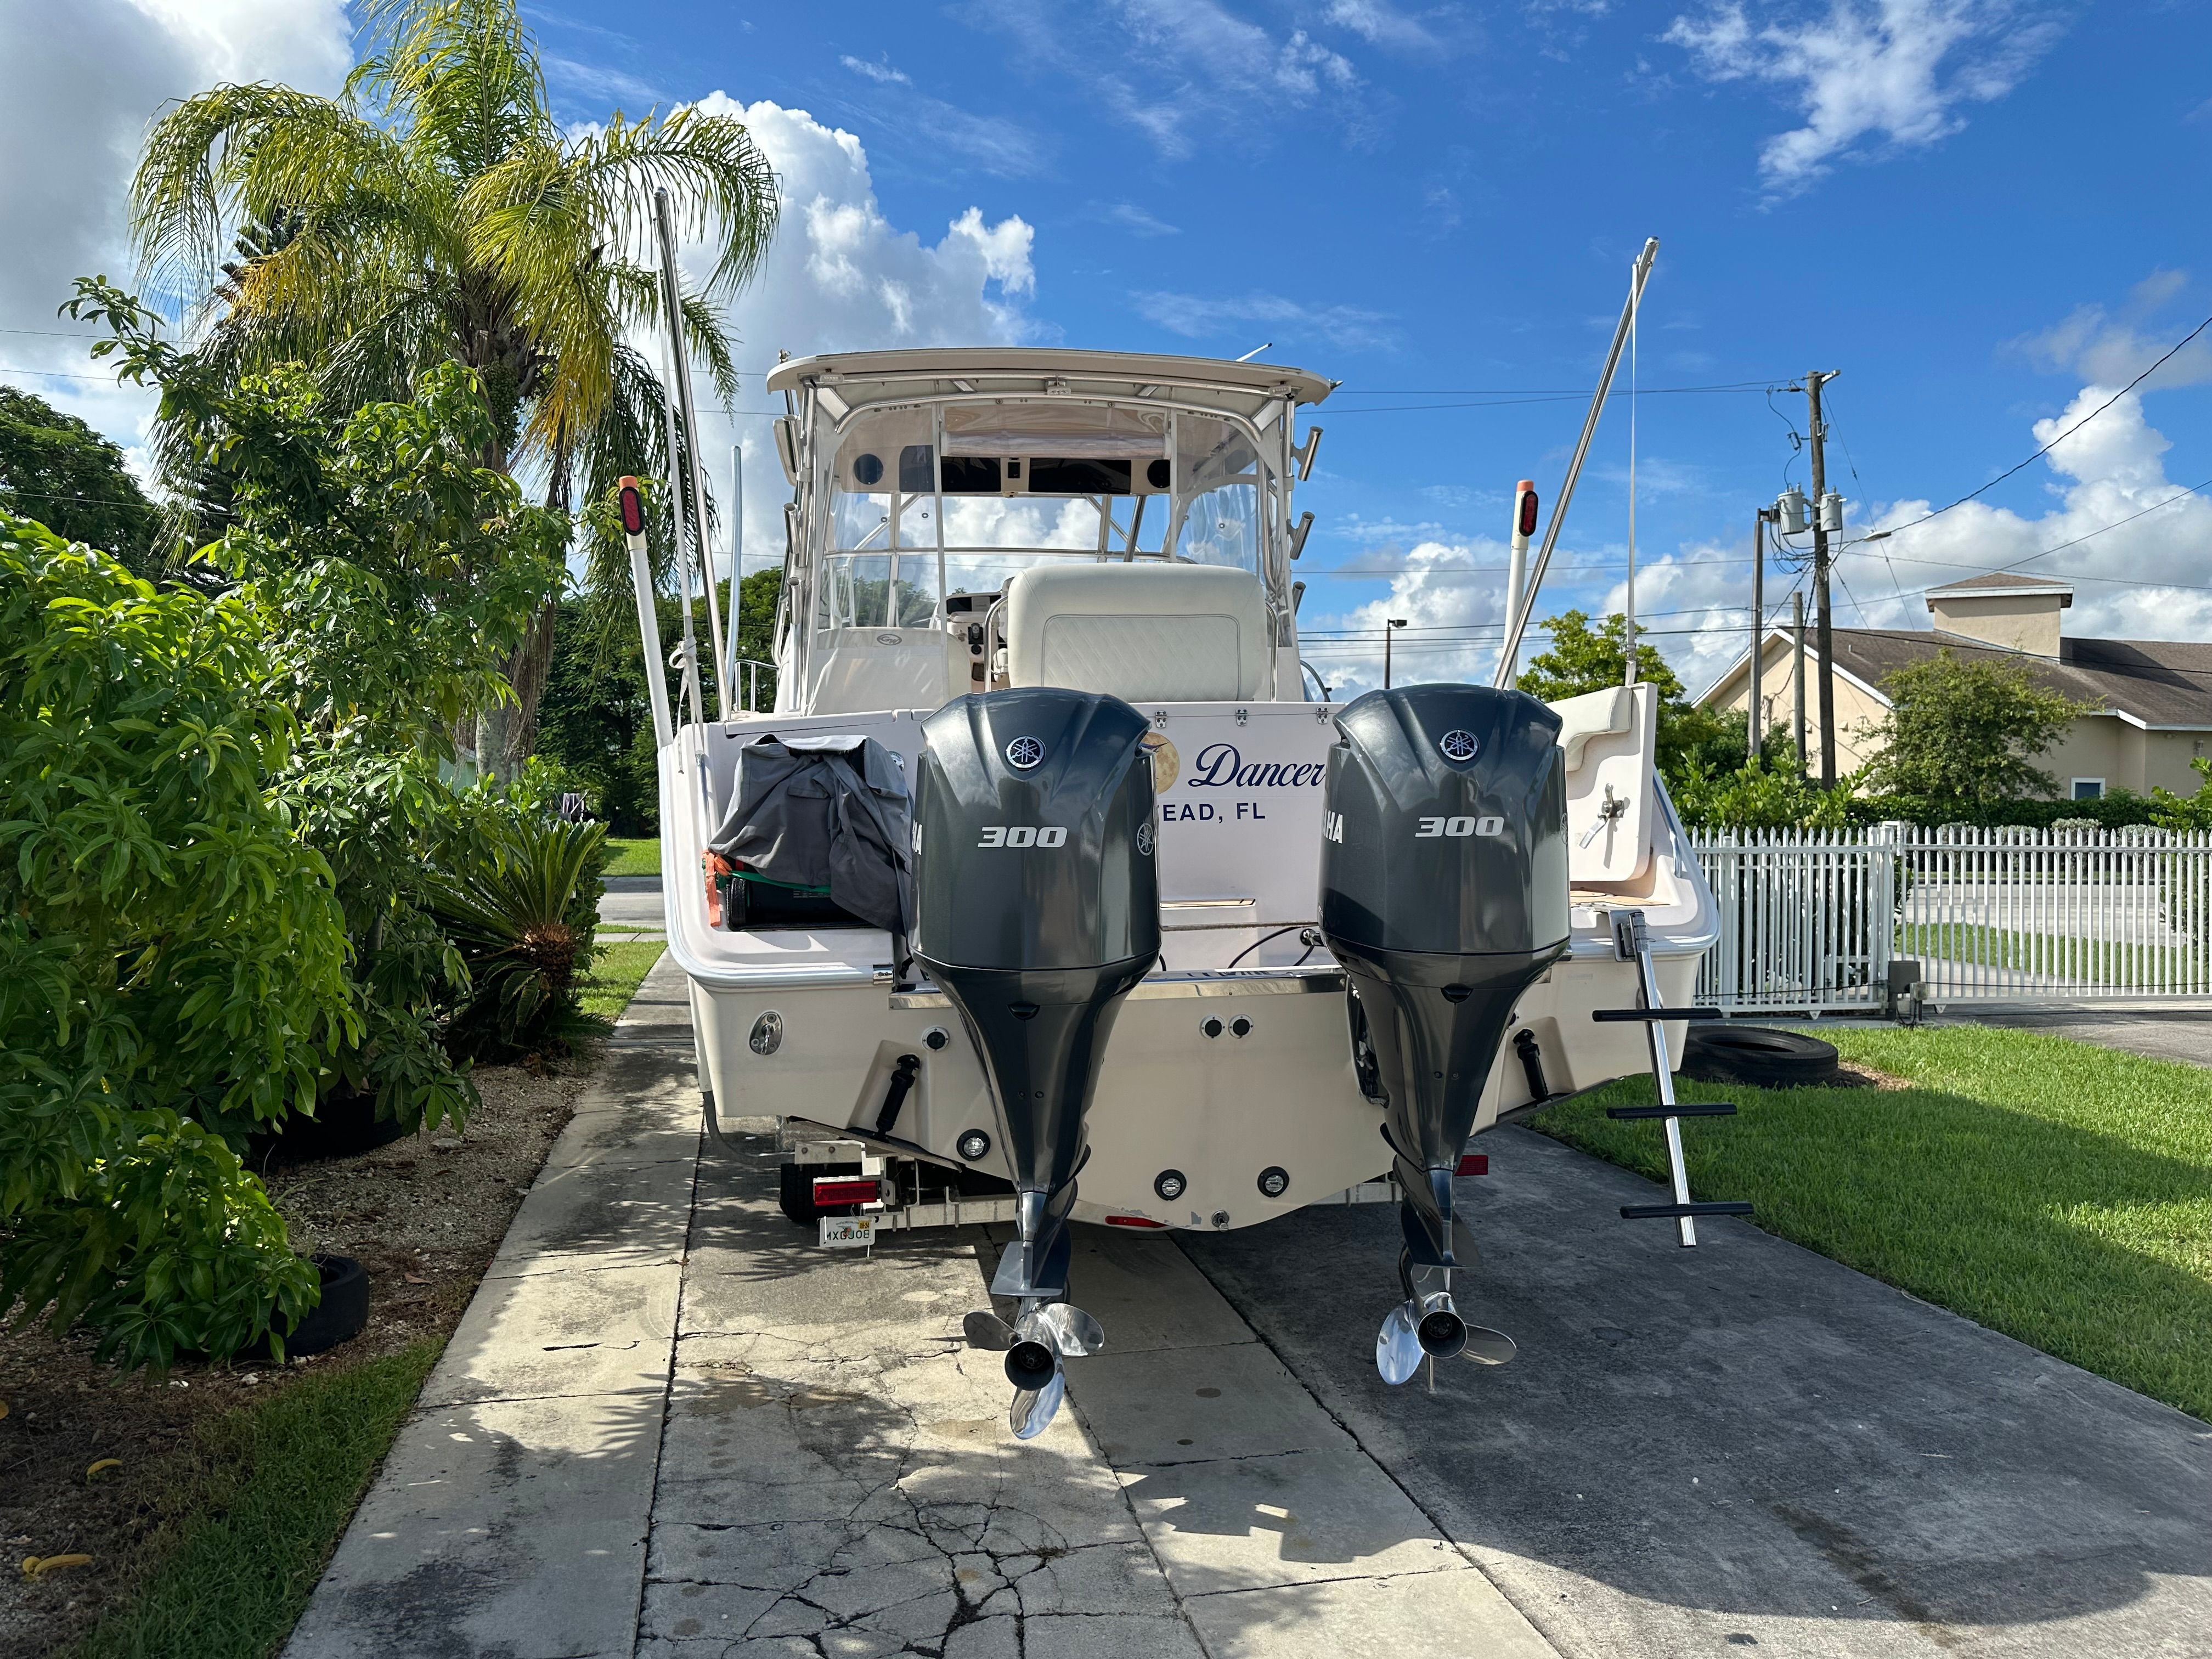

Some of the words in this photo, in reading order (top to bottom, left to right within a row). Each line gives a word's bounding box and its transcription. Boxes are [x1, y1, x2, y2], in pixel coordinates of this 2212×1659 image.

[1188, 743, 1326, 787] Dancer
[1158, 803, 1223, 823] EAD,
[1236, 802, 1266, 820] FL
[977, 826, 1068, 848] 300
[1415, 816, 1505, 837] 300
